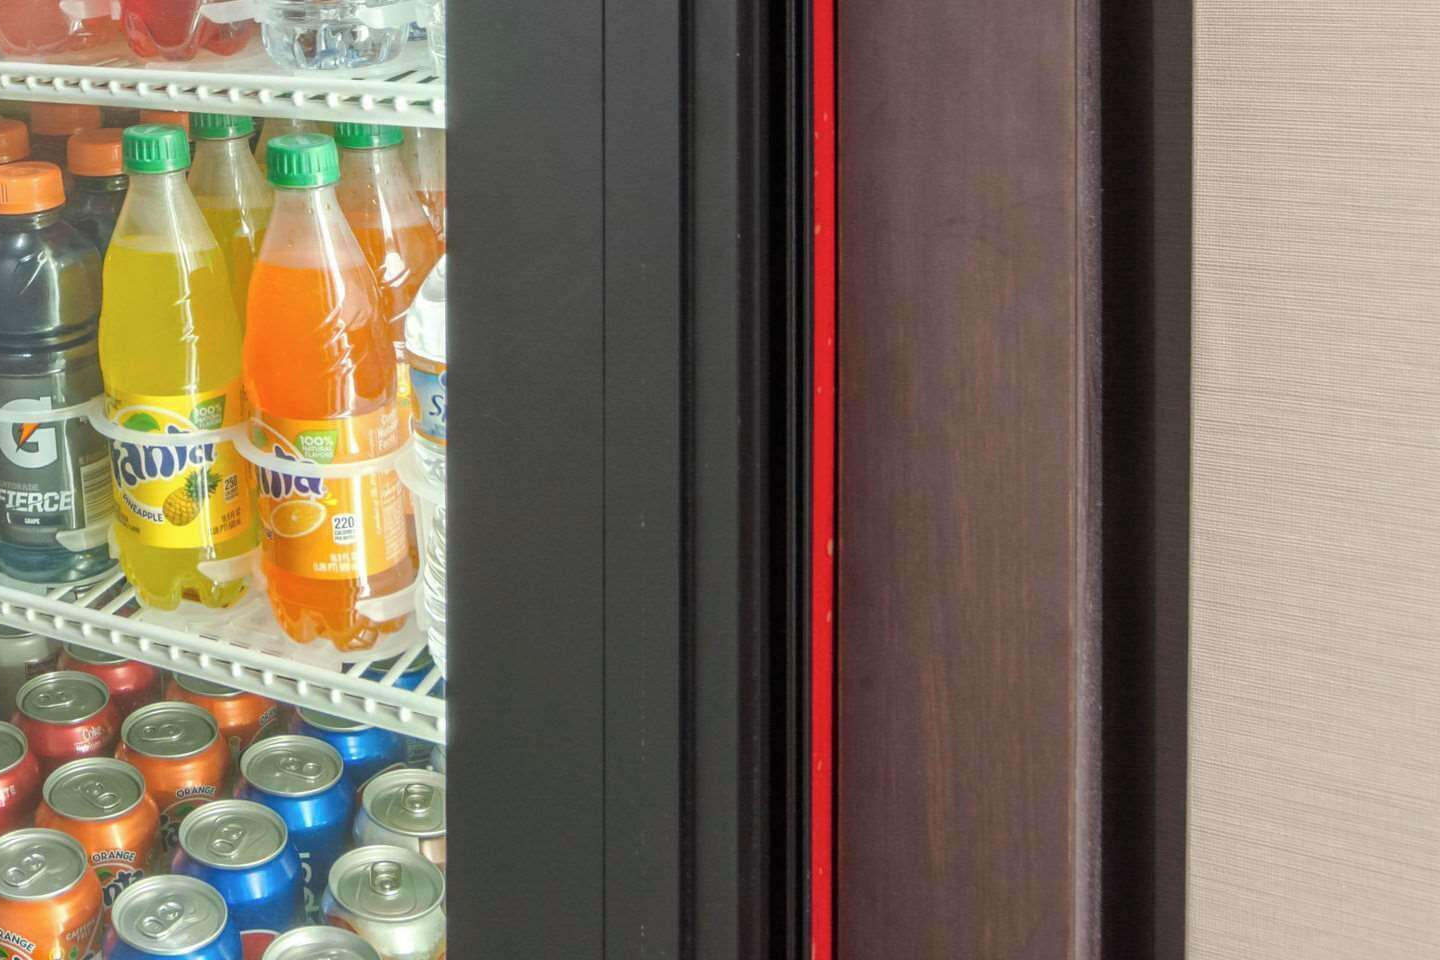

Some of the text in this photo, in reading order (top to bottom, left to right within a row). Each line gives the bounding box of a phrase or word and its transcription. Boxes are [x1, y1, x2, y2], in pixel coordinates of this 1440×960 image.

[299, 433, 335, 446] 100%
[24, 517, 41, 525] GRAPE
[333, 516, 355, 529] 220
[176, 786, 217, 799] ORANGE
[92, 849, 137, 863] ORANGE
